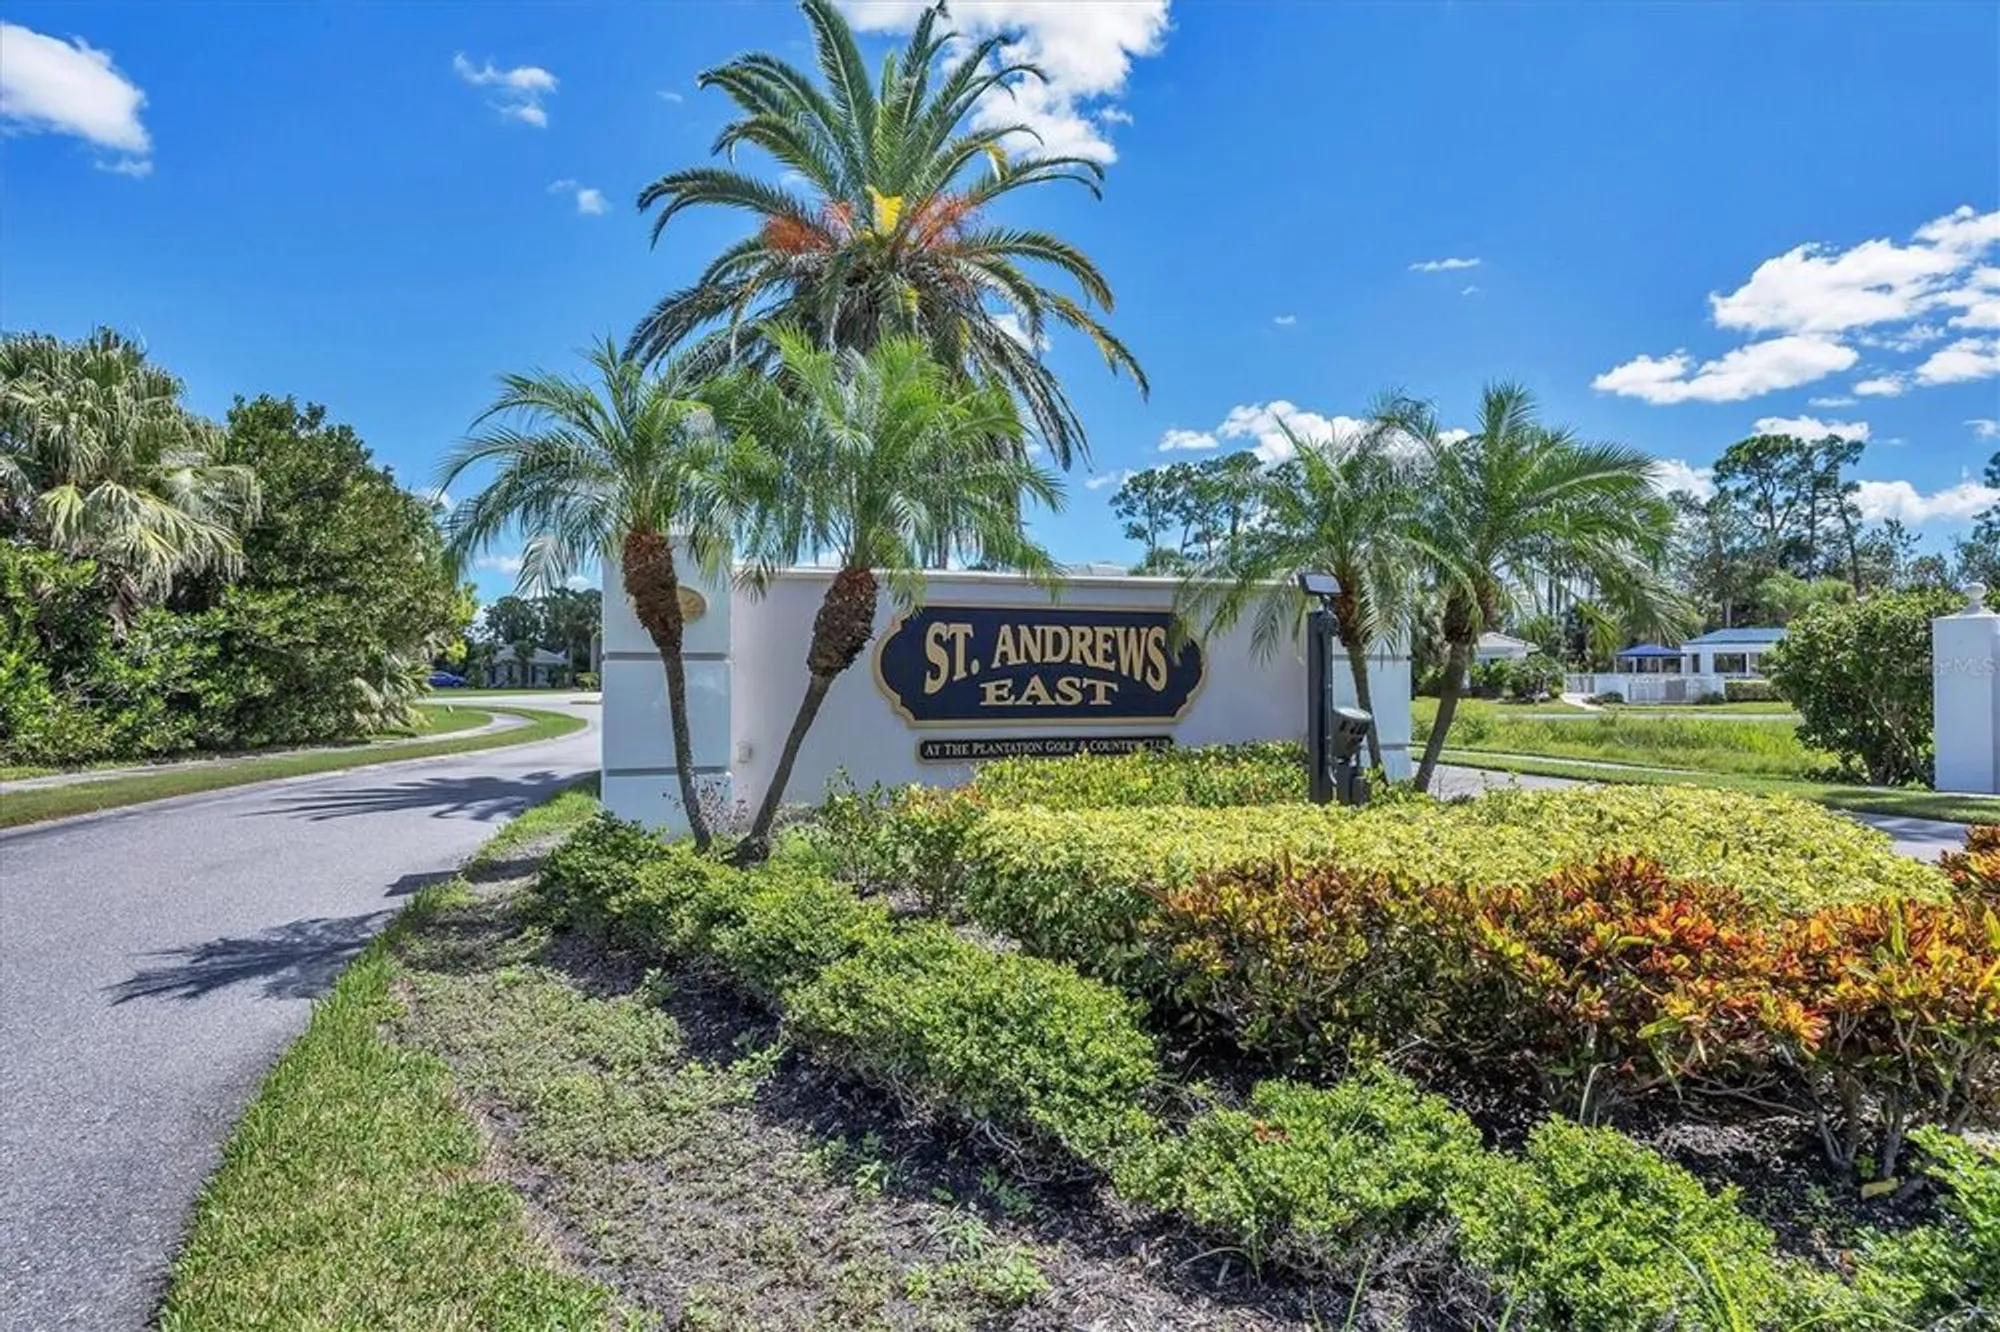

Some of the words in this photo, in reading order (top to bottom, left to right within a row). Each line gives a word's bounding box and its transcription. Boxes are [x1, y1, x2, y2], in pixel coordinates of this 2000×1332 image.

[924, 621, 980, 695] ST.
[991, 623, 1168, 692] ANDREWS
[979, 674, 1119, 706] EAST
[924, 743, 941, 755] AT
[944, 742, 969, 755] THE
[972, 741, 1043, 754] PLANTATION
[1046, 740, 1076, 752] GOLF
[1078, 739, 1086, 751] &
